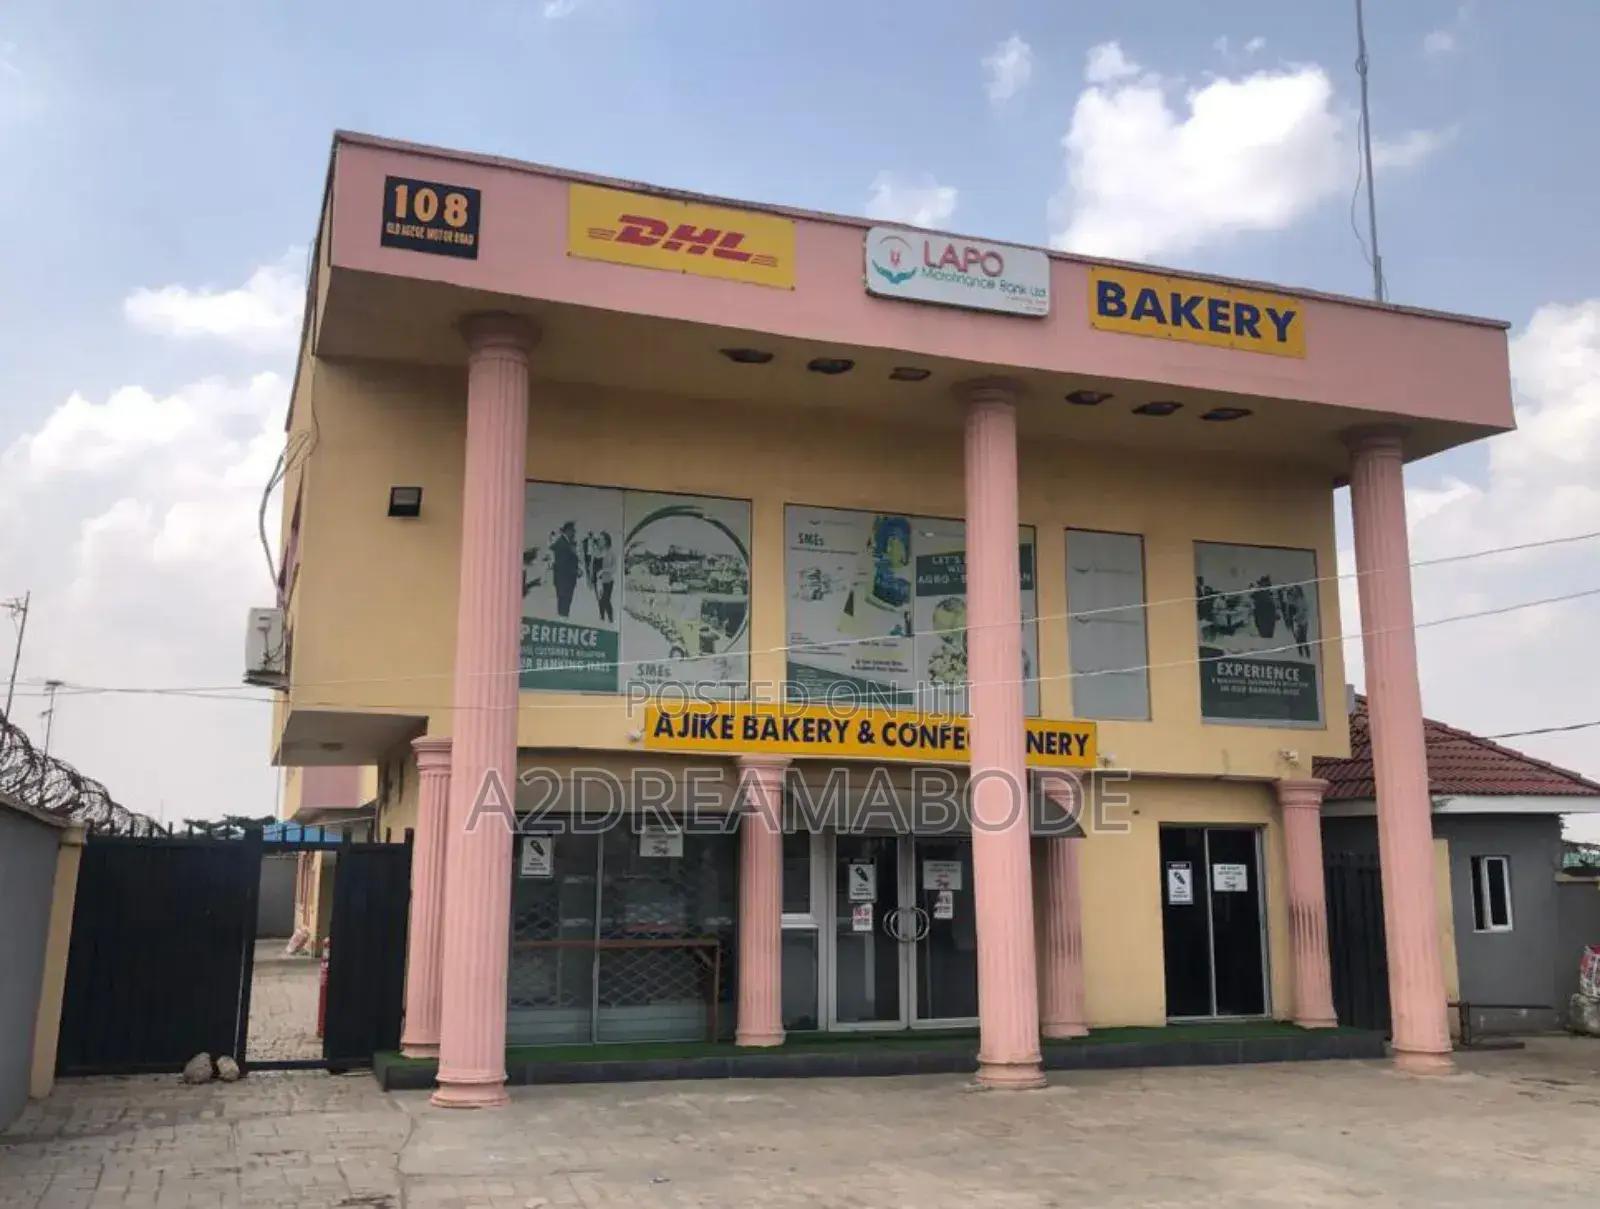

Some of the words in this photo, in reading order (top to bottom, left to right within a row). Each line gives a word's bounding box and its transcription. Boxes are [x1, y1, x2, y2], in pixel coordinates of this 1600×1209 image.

[395, 184, 469, 228] 108
[613, 213, 753, 263] DHL
[923, 239, 1004, 277] LAPO
[919, 266, 996, 290] Microfinance
[999, 279, 1027, 294] Bank
[1095, 278, 1298, 344] BAKERY
[519, 623, 598, 647] PERIENCE
[637, 663, 672, 677] SMEs
[1216, 661, 1300, 682] EXPERIENCE
[653, 712, 735, 740] AJIKE
[742, 715, 849, 745] BAKERY
[857, 719, 876, 745] &
[881, 721, 1089, 757] CONFENERY
